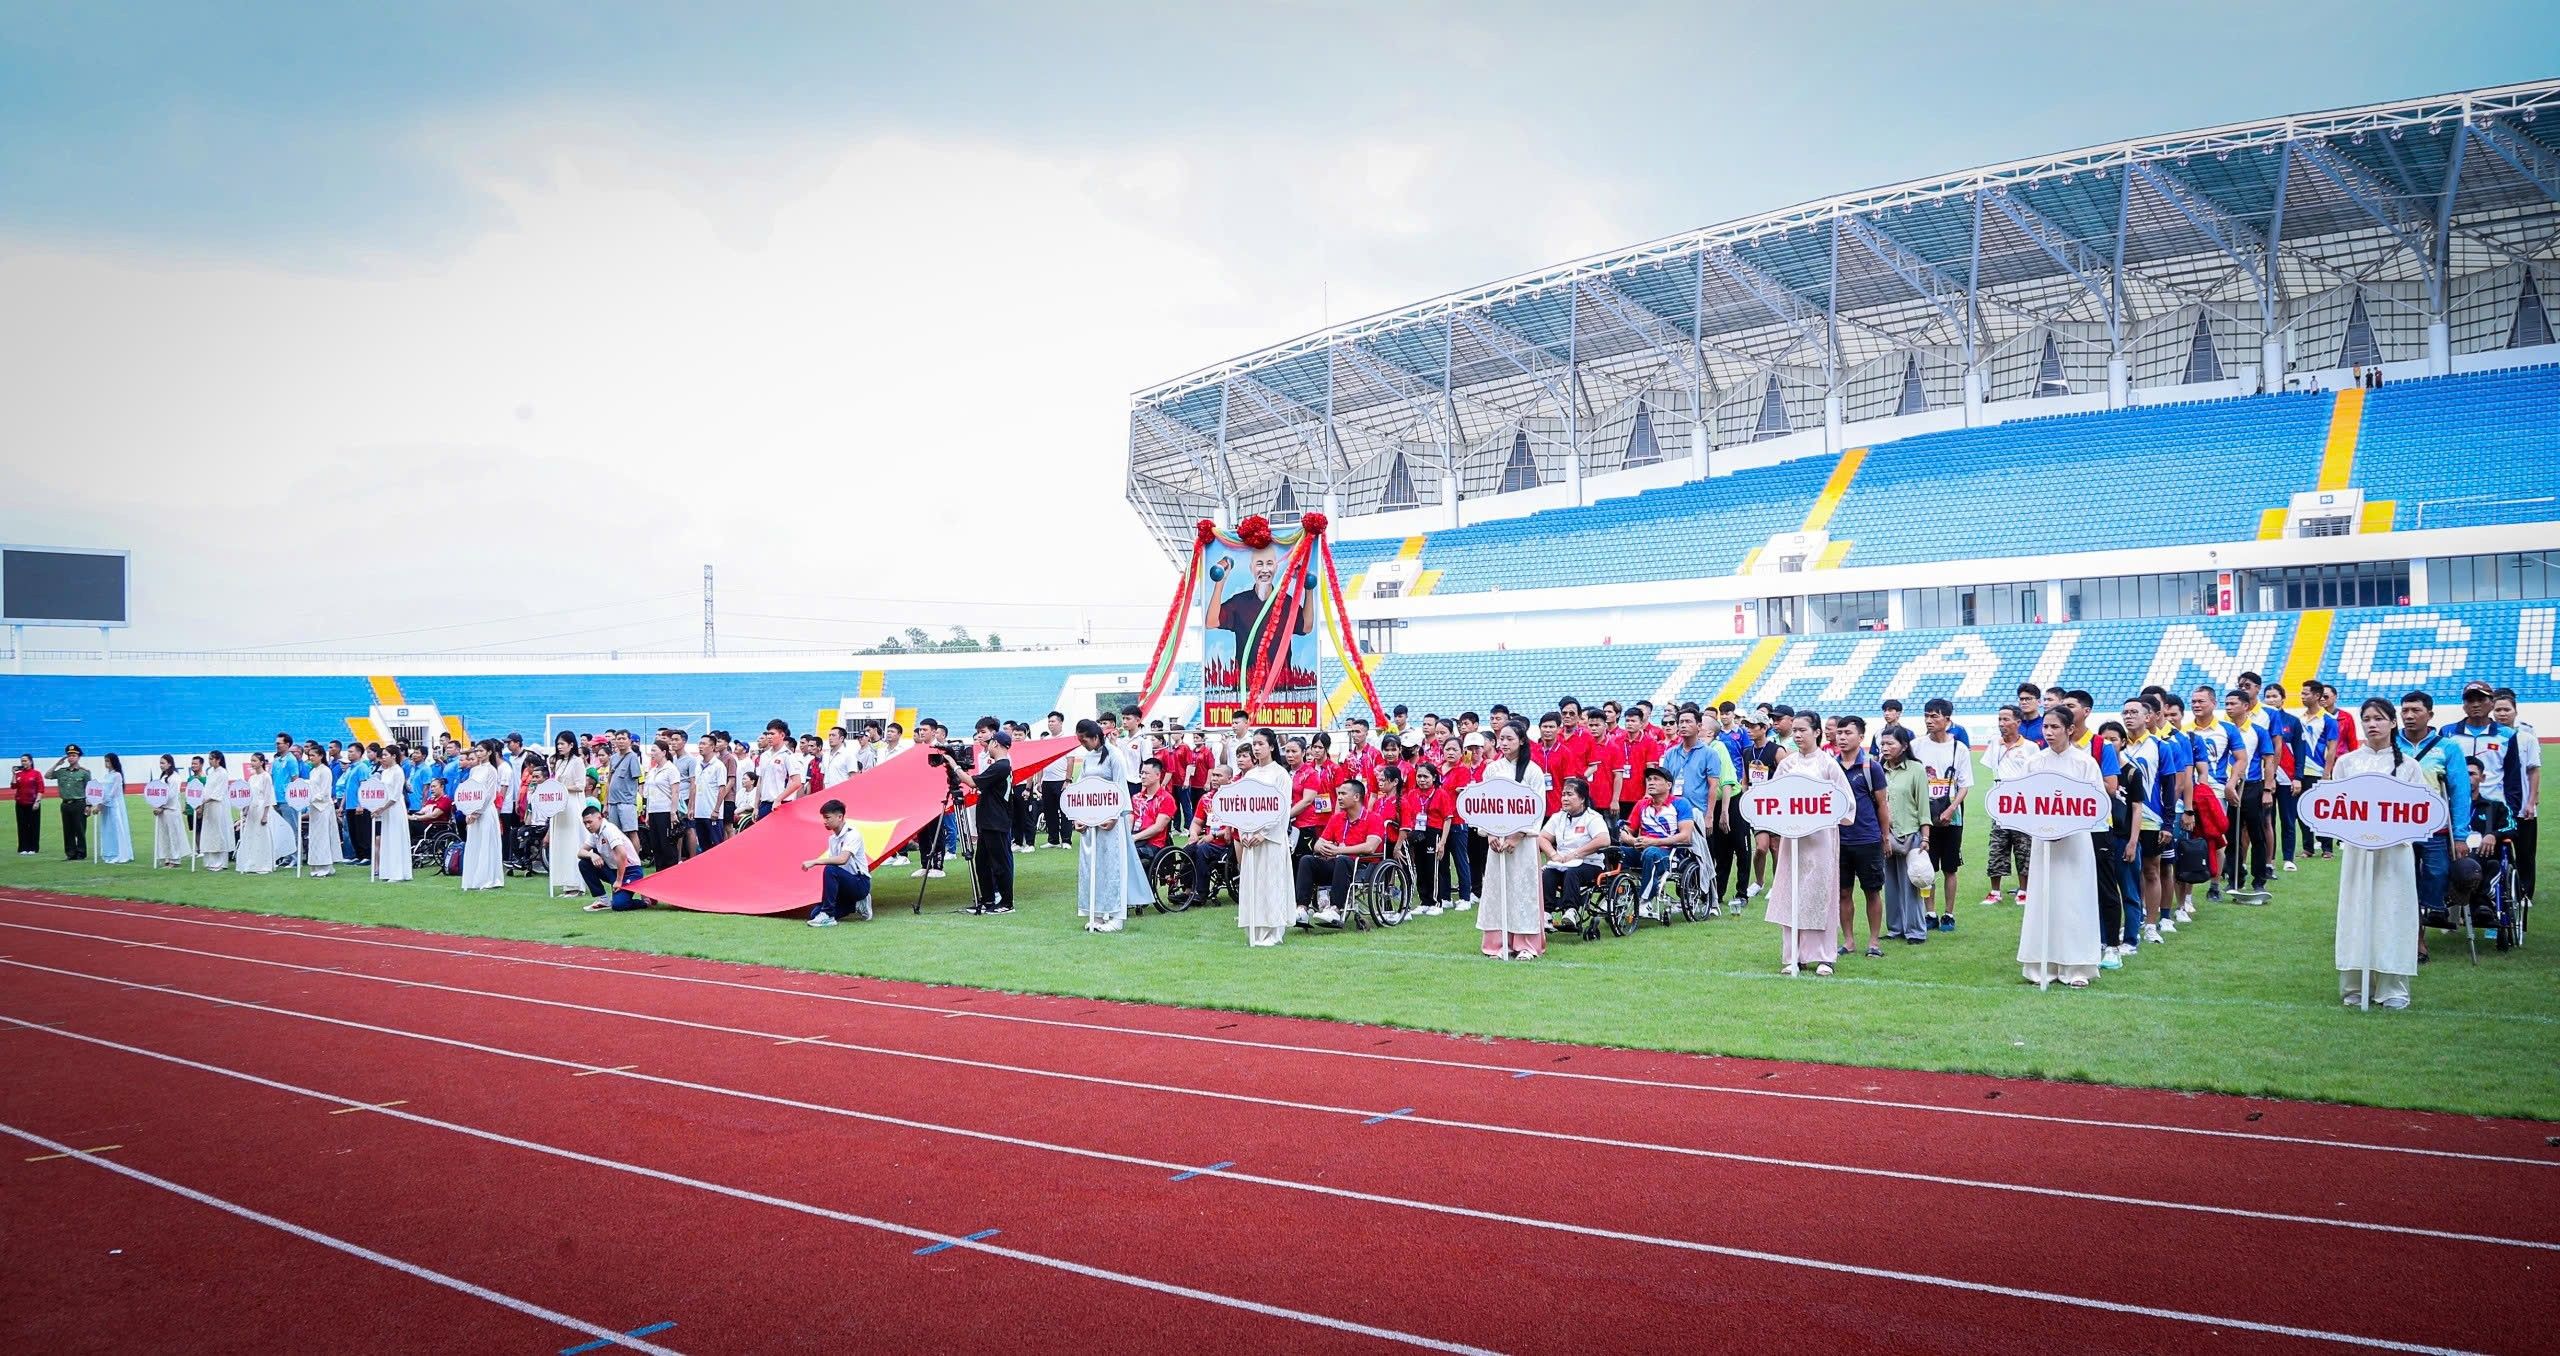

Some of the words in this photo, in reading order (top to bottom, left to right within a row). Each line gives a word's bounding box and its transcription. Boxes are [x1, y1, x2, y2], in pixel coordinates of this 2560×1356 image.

[1210, 706, 1220, 727] TỰ
[1274, 705, 1296, 725] CŨNG
[1298, 705, 1313, 727] TẬP
[1751, 770, 1765, 780] 095
[298, 788, 309, 799] NỘI
[473, 790, 483, 801] NAI
[1067, 790, 1084, 807] THÁI
[1086, 789, 1119, 807] NGUYÊN
[1932, 786, 1950, 796] 075
[1218, 794, 1247, 812] TUYÊN
[1249, 796, 1279, 812] QUANG
[1464, 792, 1504, 815] QUẢNG
[1507, 795, 1536, 815] NGÃI
[1754, 798, 1782, 815] TP.
[1789, 790, 1833, 815] HUẾ
[1998, 791, 2027, 814] ĐÀ
[2034, 789, 2097, 817] NẴNG
[2313, 792, 2368, 821] CẦN
[2377, 800, 2430, 825] THƠ
